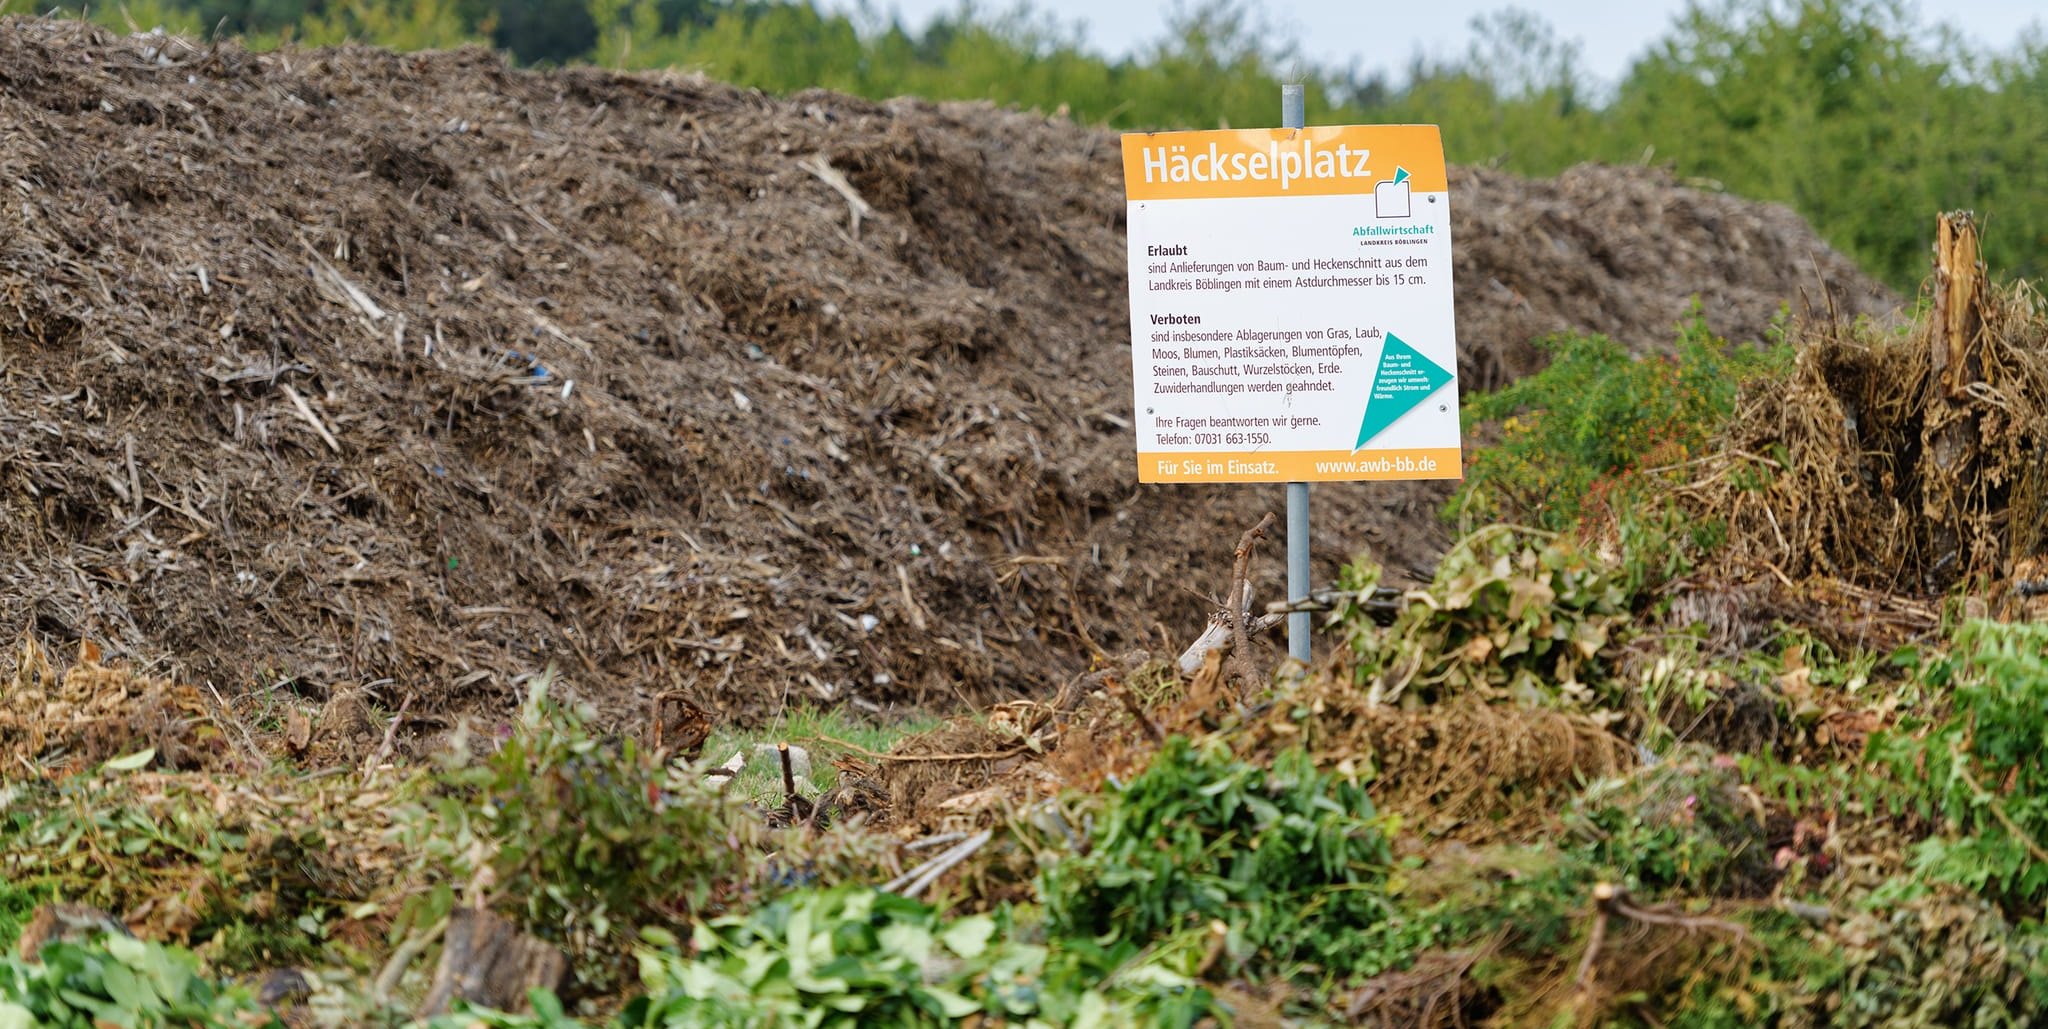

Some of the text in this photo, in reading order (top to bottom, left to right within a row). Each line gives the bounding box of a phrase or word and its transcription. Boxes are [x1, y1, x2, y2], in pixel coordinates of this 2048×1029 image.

[1142, 139, 1372, 190] Häckselplatz
[1352, 224, 1434, 237] Abfallwirtschaft
[1147, 245, 1187, 257] Erlaubt
[1147, 257, 1428, 276] sind Anlieferungen von Baum- und Heckenschnitt aus dem
[1148, 274, 1426, 292] Landkreis Böblingen mit einem Astdurchmesser bis 15 cm.
[1150, 314, 1201, 325] Verboten
[1151, 326, 1382, 343] sind insbesondere Ablagerungen von Gras, Laub,
[1152, 344, 1363, 361] Moos, Blumen, Plastiksäcken, Blumentöpfen,
[1152, 362, 1342, 378] Steinen, Bauschutt, Wurzelstöcken, Erde.
[1153, 379, 1335, 396] Zuwiderhandlungen werden geahndet.
[1155, 414, 1321, 430] Ihre Fragen beantworten wir gerne.
[1155, 432, 1271, 445] Telefon: 07031 663-1550.
[1157, 458, 1279, 475] Für Sie im Einsatz.
[1315, 456, 1437, 473] www.awb-bb.de
